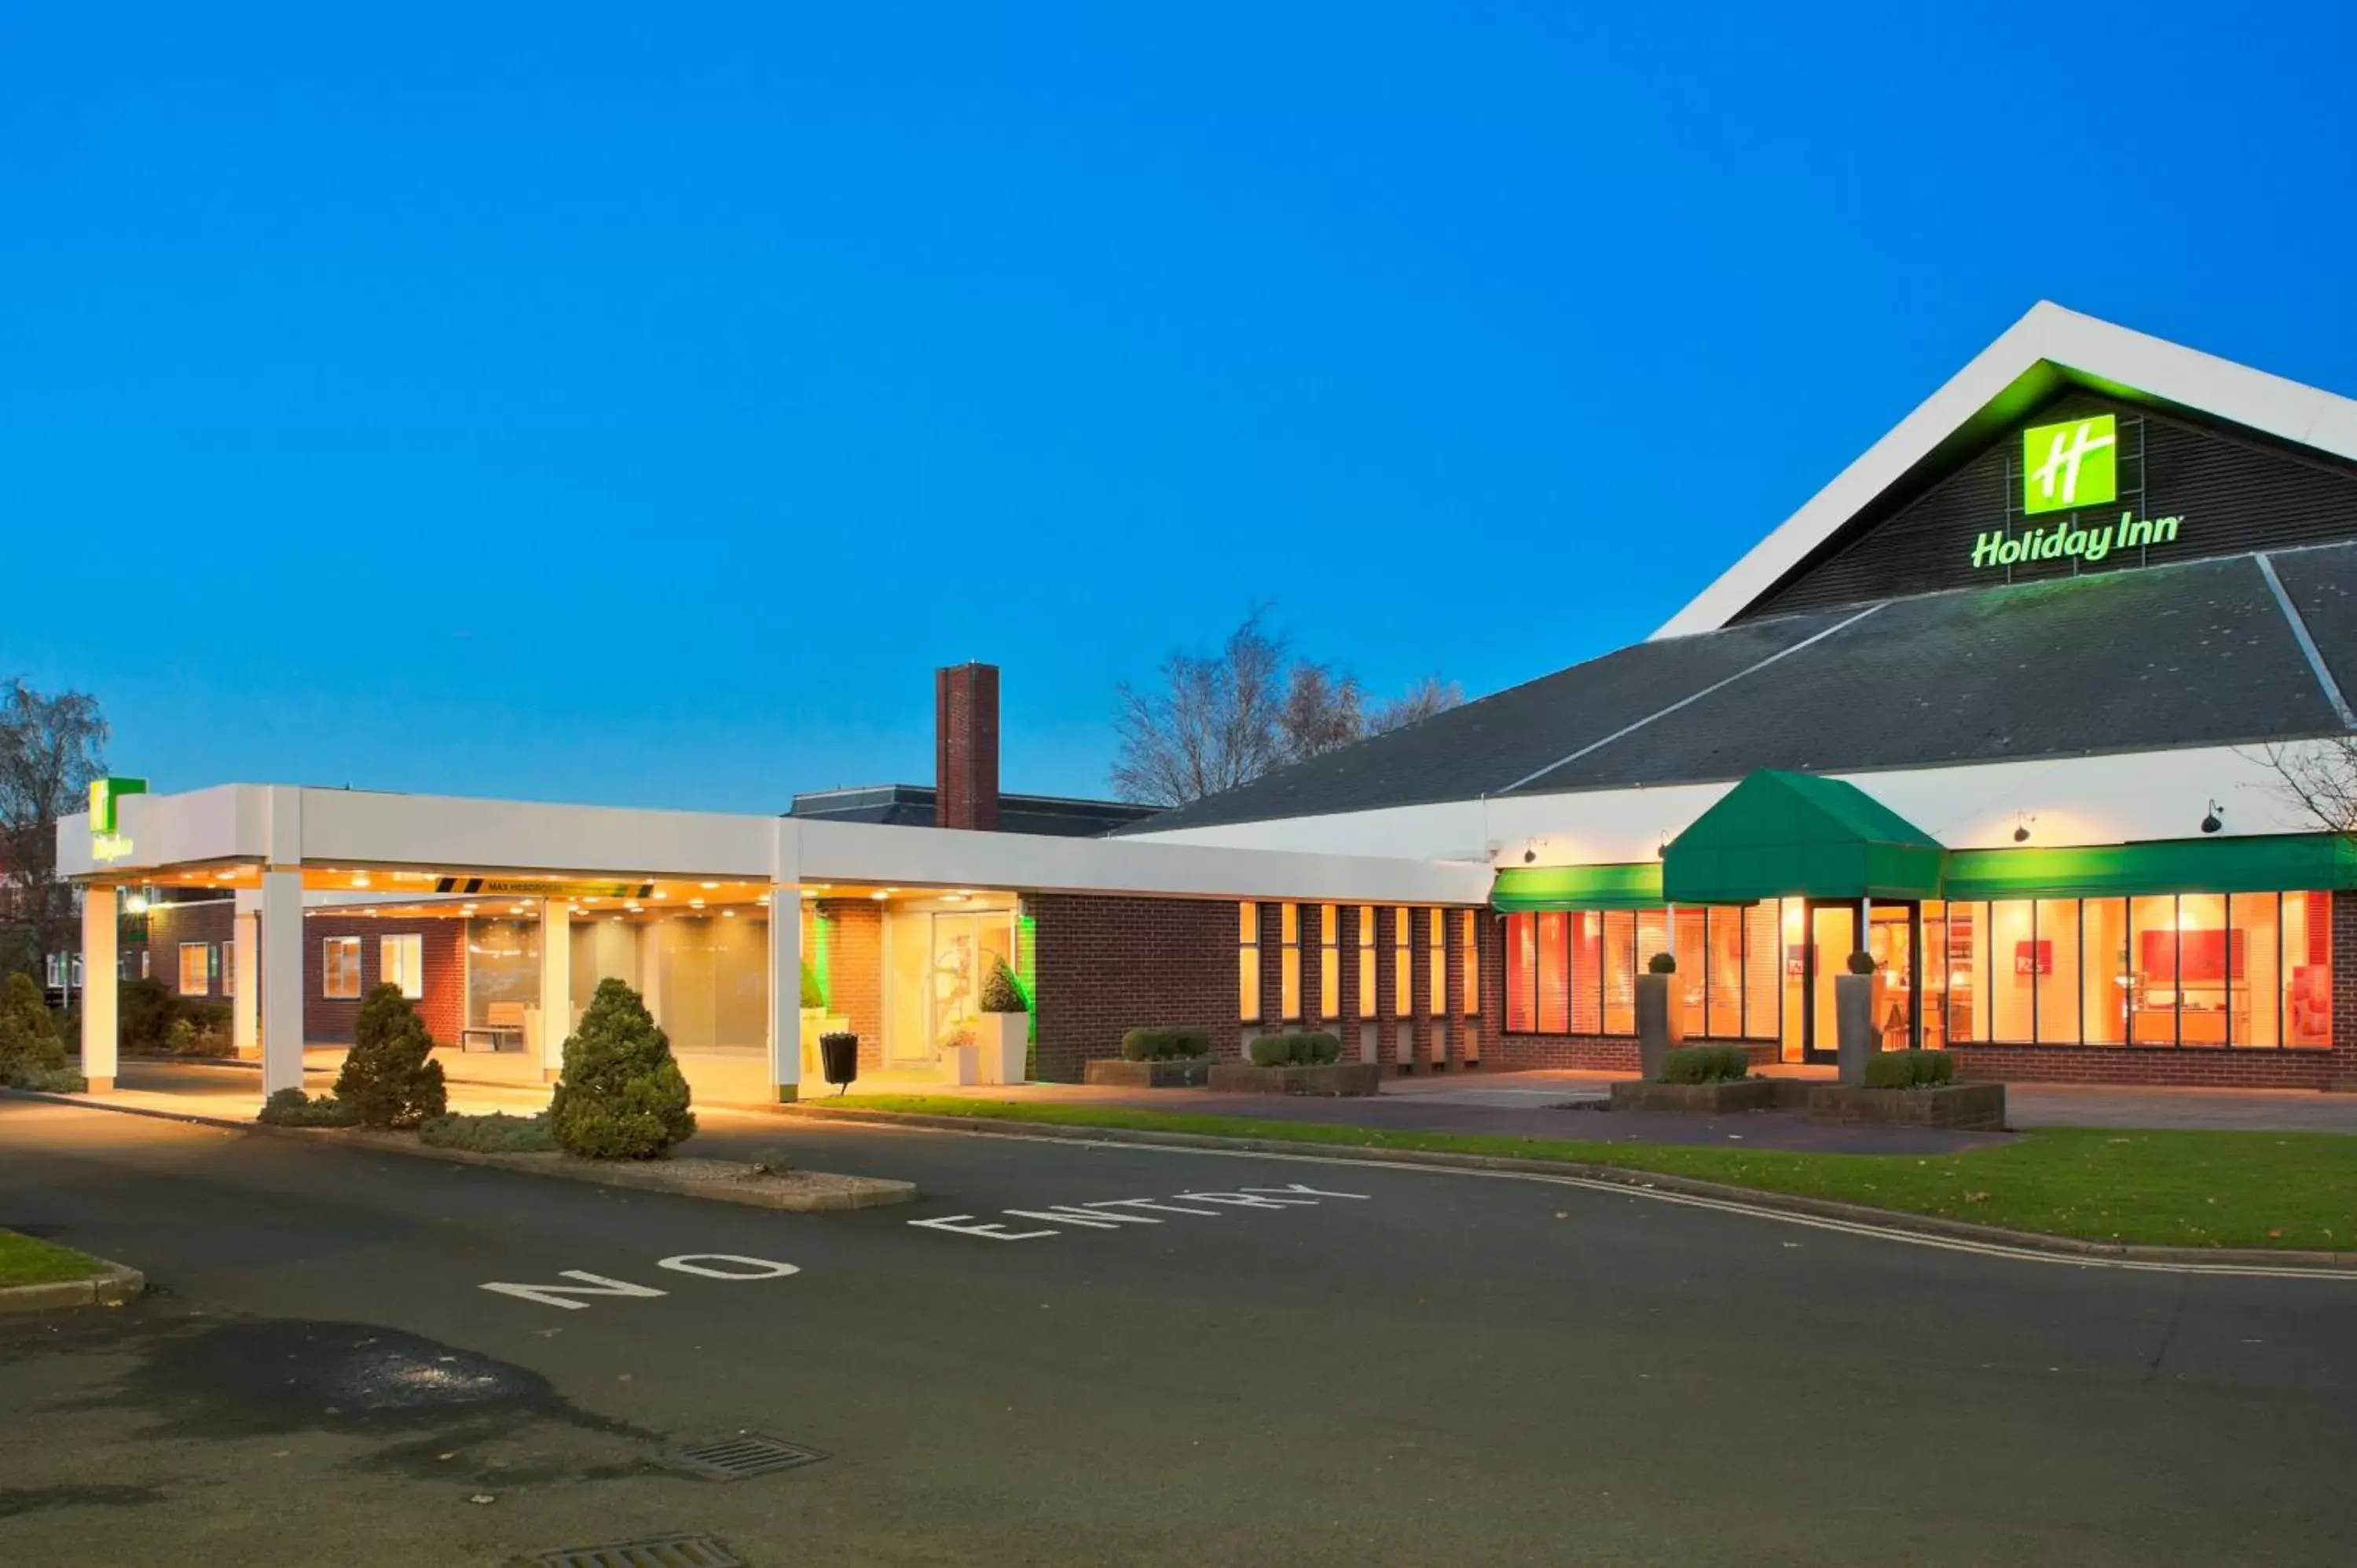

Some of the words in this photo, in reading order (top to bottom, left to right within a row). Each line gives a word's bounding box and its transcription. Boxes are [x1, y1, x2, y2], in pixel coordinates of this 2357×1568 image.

[1971, 522, 2113, 567] Holiday
[2117, 511, 2179, 548] Inn
[488, 881, 508, 892] MAX
[478, 1254, 801, 1310] NO
[907, 1183, 1371, 1240] ENTRY
